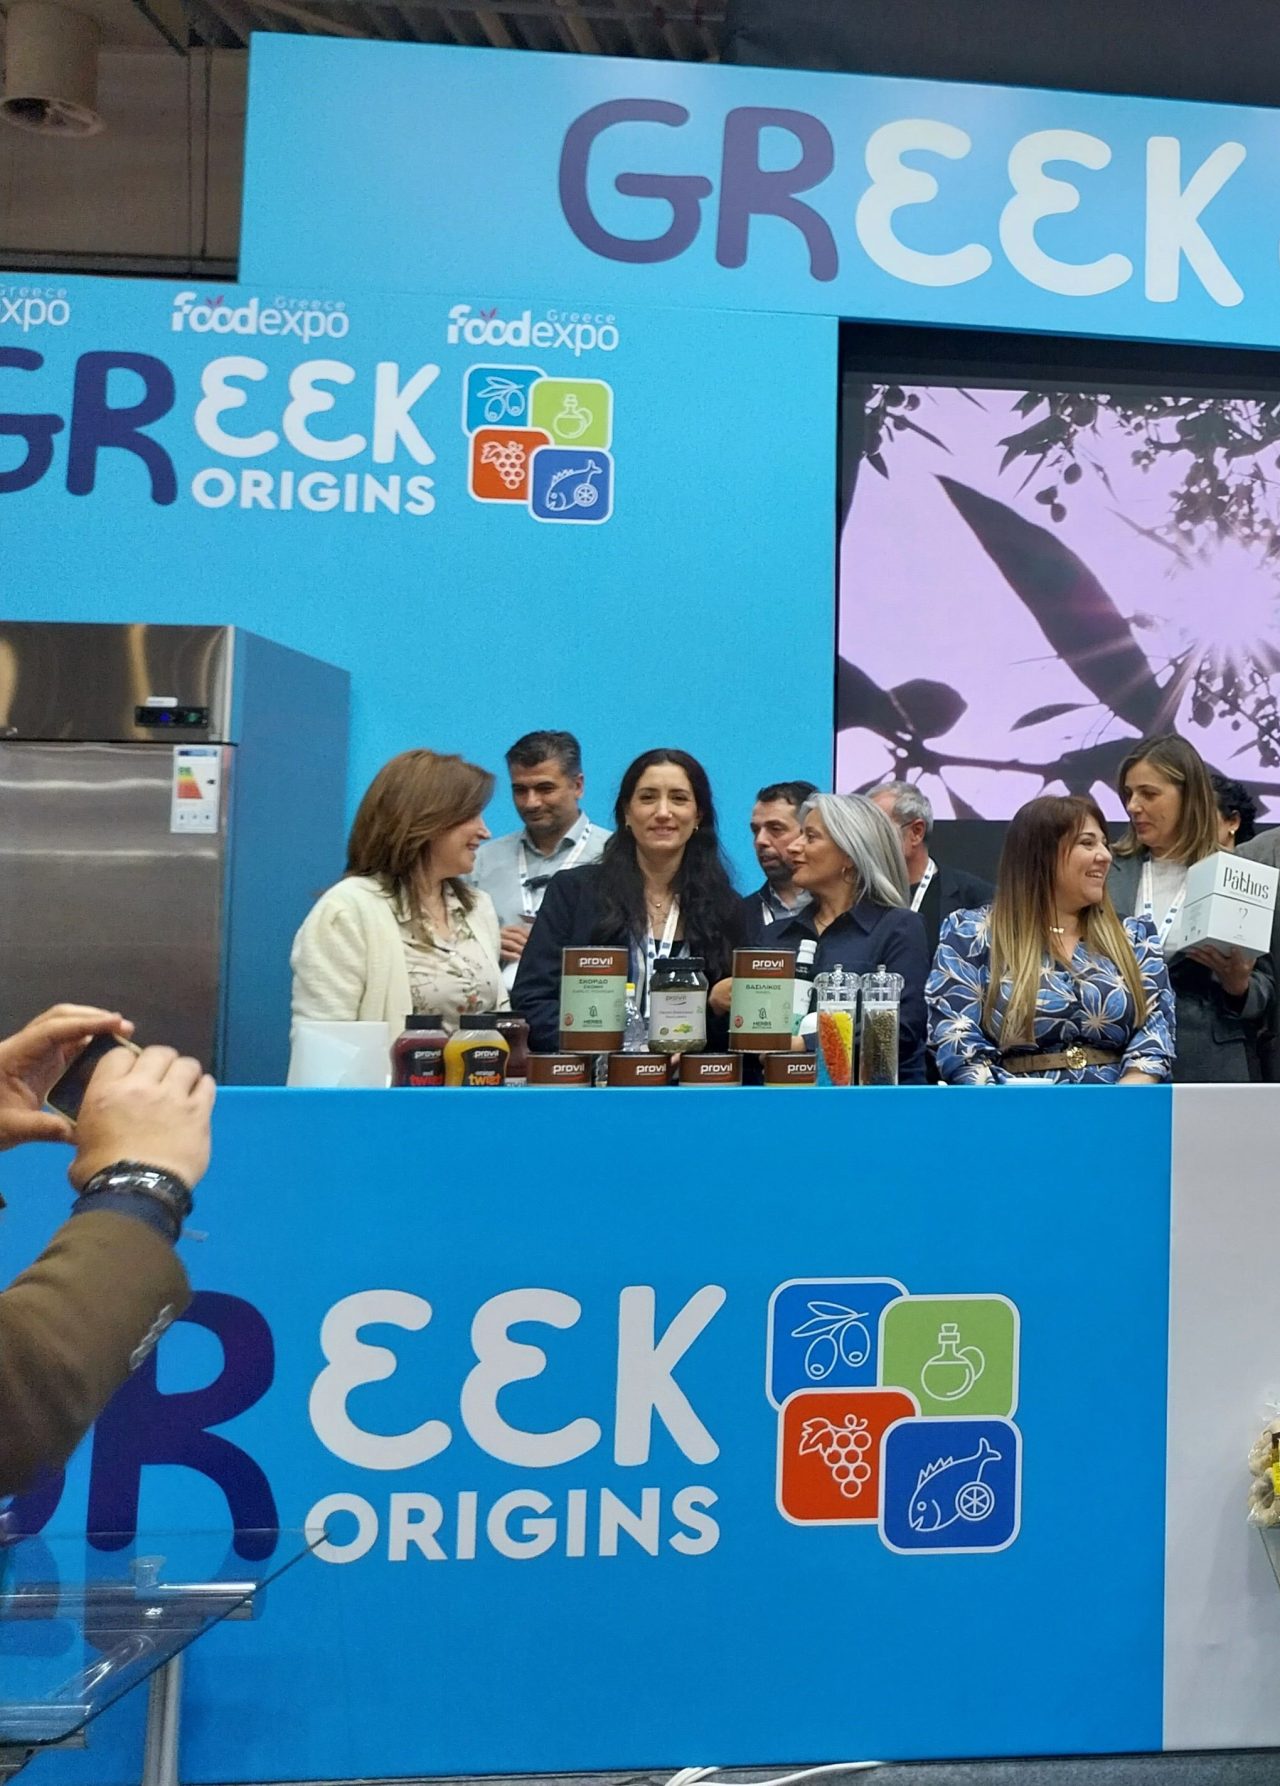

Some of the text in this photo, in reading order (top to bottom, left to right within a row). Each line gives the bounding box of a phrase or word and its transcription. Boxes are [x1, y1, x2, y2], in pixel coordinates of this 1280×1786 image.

[557, 97, 1246, 310] GREEK
[275, 296, 345, 311] Greece
[171, 291, 349, 344] foodexpo
[546, 309, 616, 324] Greece
[447, 304, 619, 356] foodexpo
[191, 467, 436, 517] ORIGINS
[579, 956, 613, 968] provil
[752, 959, 784, 970] provil
[474, 1050, 500, 1059] provil
[553, 1063, 585, 1075] provil
[636, 1063, 667, 1075] provil
[700, 1062, 733, 1075] provil
[787, 1063, 817, 1074] provi
[468, 1073, 501, 1086] twist
[0, 1284, 727, 1563] REEK
[305, 1487, 722, 1564] ORIGINS
